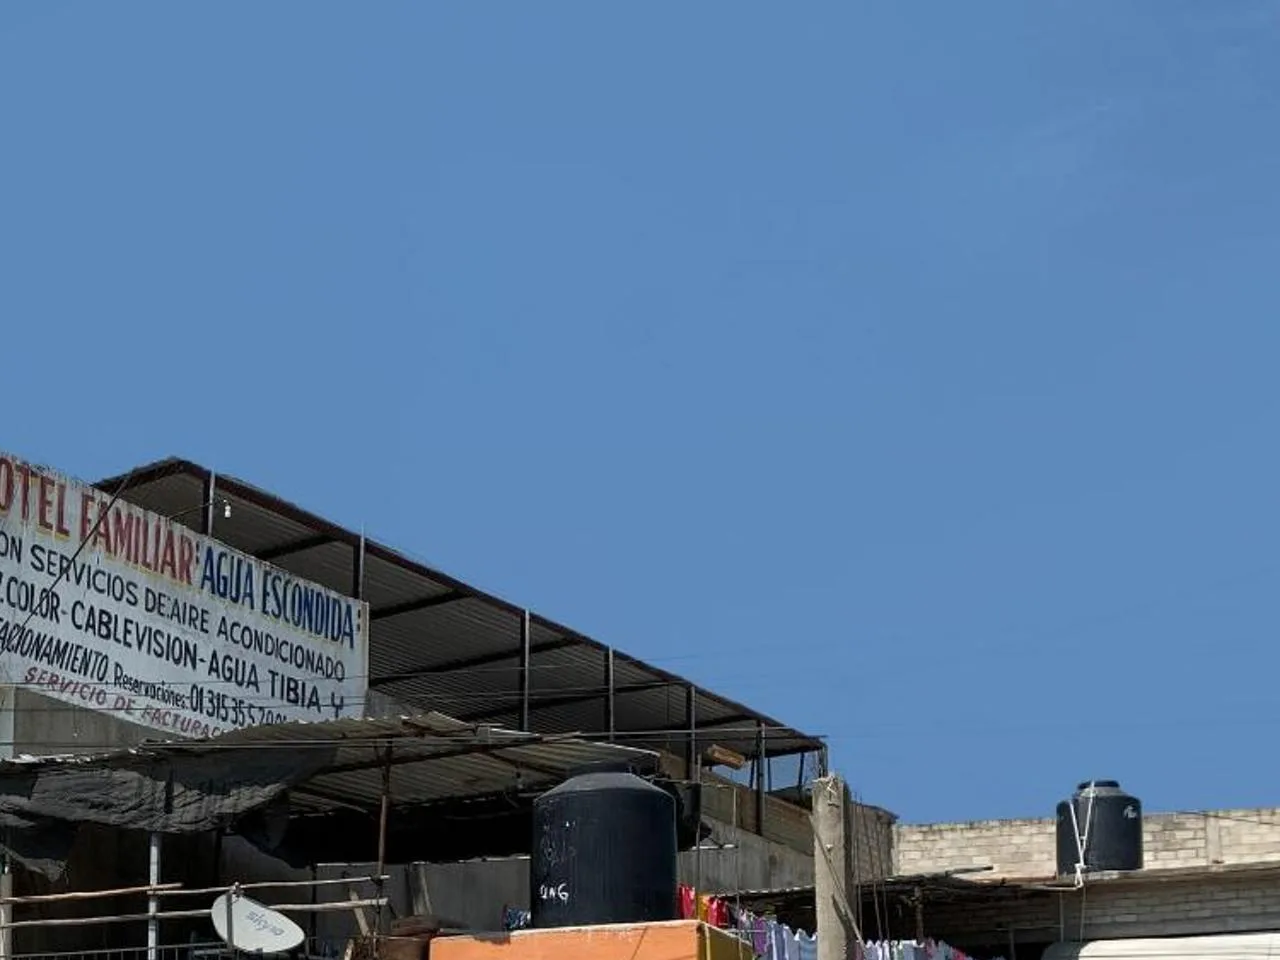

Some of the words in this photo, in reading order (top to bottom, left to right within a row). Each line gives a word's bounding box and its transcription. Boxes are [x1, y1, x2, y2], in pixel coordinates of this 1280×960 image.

[80, 491, 194, 585] FAMILIAR
[30, 543, 139, 607] SERVICIOS
[216, 615, 347, 684] ACONDICIONADO
[24, 666, 108, 706] SERVICIO
[113, 695, 136, 717] DE
[140, 702, 221, 739] FACTURAC
[268, 669, 322, 713] TIBIA
[330, 691, 345, 719] Y
